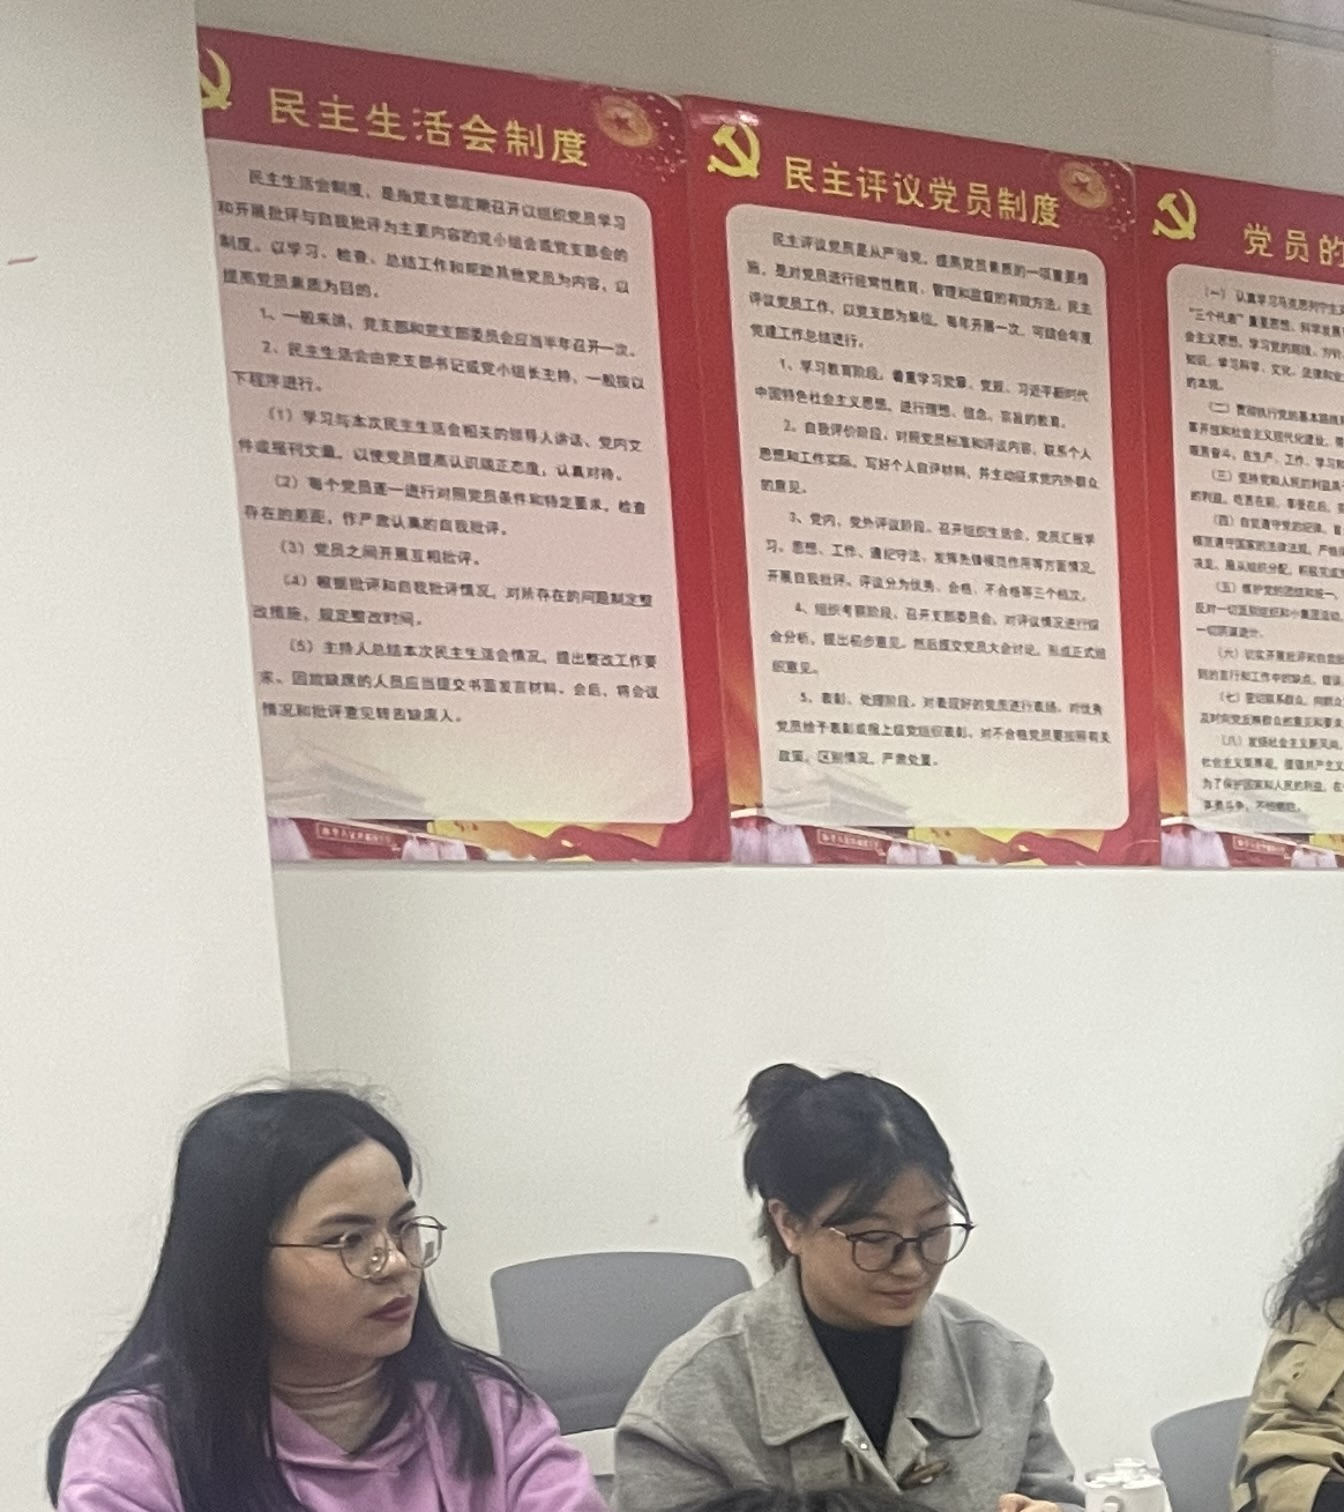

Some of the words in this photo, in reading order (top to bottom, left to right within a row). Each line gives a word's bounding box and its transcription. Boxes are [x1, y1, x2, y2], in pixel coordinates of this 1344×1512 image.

[269, 87, 590, 167] 民主生活会制度
[782, 154, 1062, 231] 民主评议党员制度
